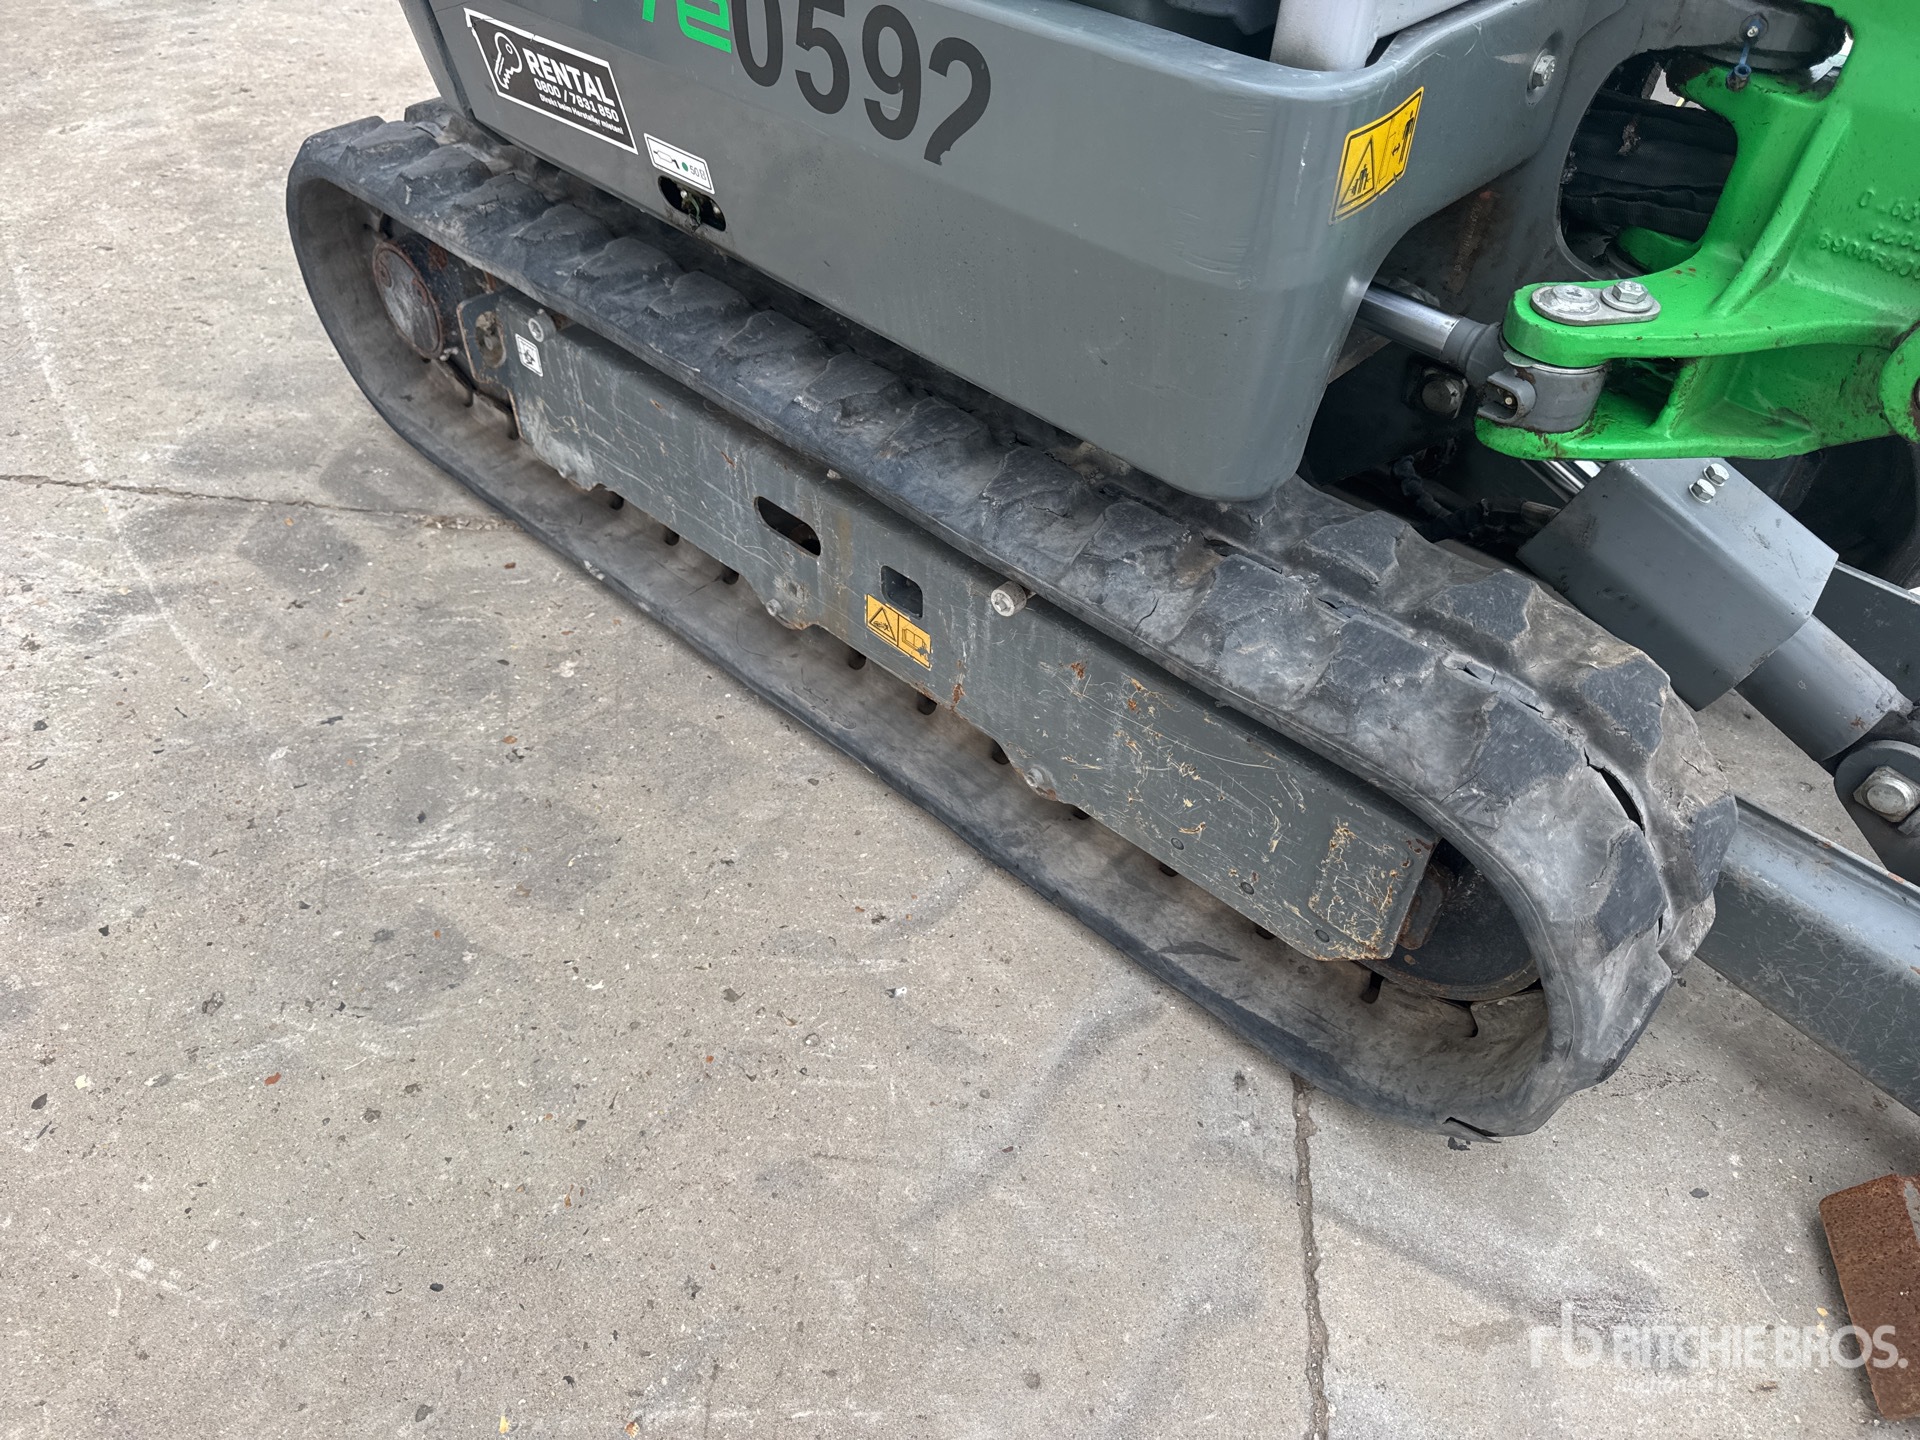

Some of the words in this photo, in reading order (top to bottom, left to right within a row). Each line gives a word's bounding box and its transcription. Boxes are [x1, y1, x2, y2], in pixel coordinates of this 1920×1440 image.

[522, 47, 616, 107] RENTAL
[533, 77, 562, 99] 0800
[568, 91, 598, 114] 7831
[597, 103, 620, 123] 850
[731, 0, 992, 166] 0592
